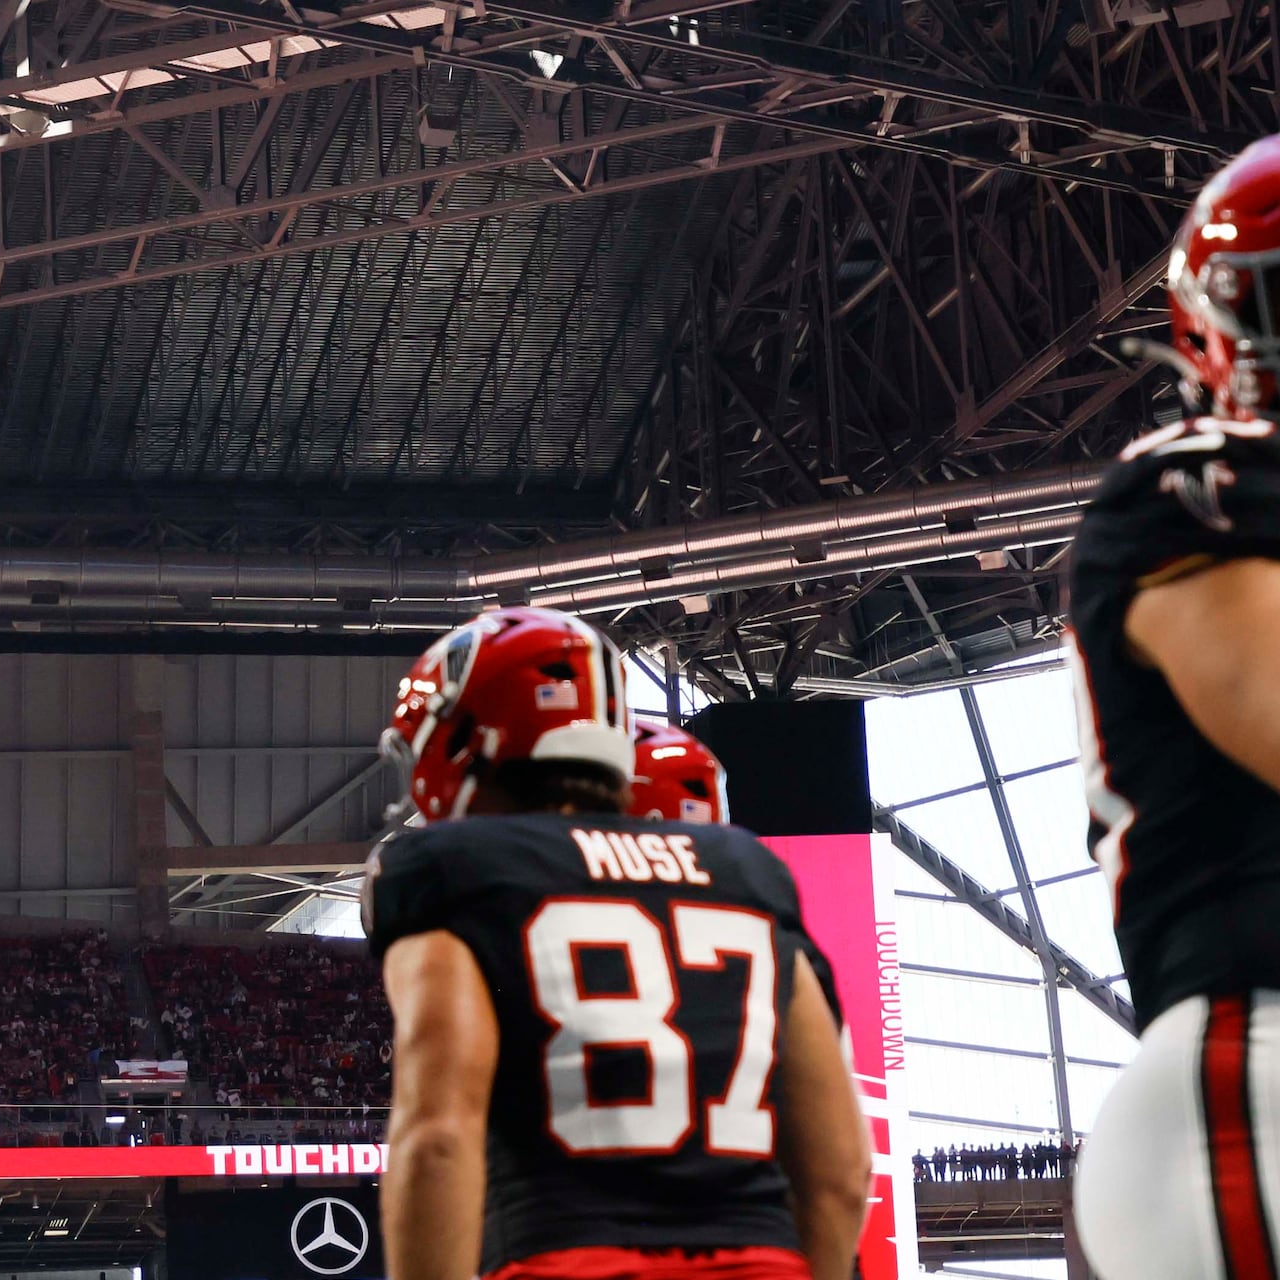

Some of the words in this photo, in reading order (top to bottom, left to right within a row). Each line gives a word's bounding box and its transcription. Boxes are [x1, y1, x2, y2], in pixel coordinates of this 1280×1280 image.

[570, 828, 712, 885] MUSE
[523, 896, 778, 1160] 87
[875, 921, 905, 1070] TOUCHDOWN
[206, 1143, 390, 1176] TOUCHD
